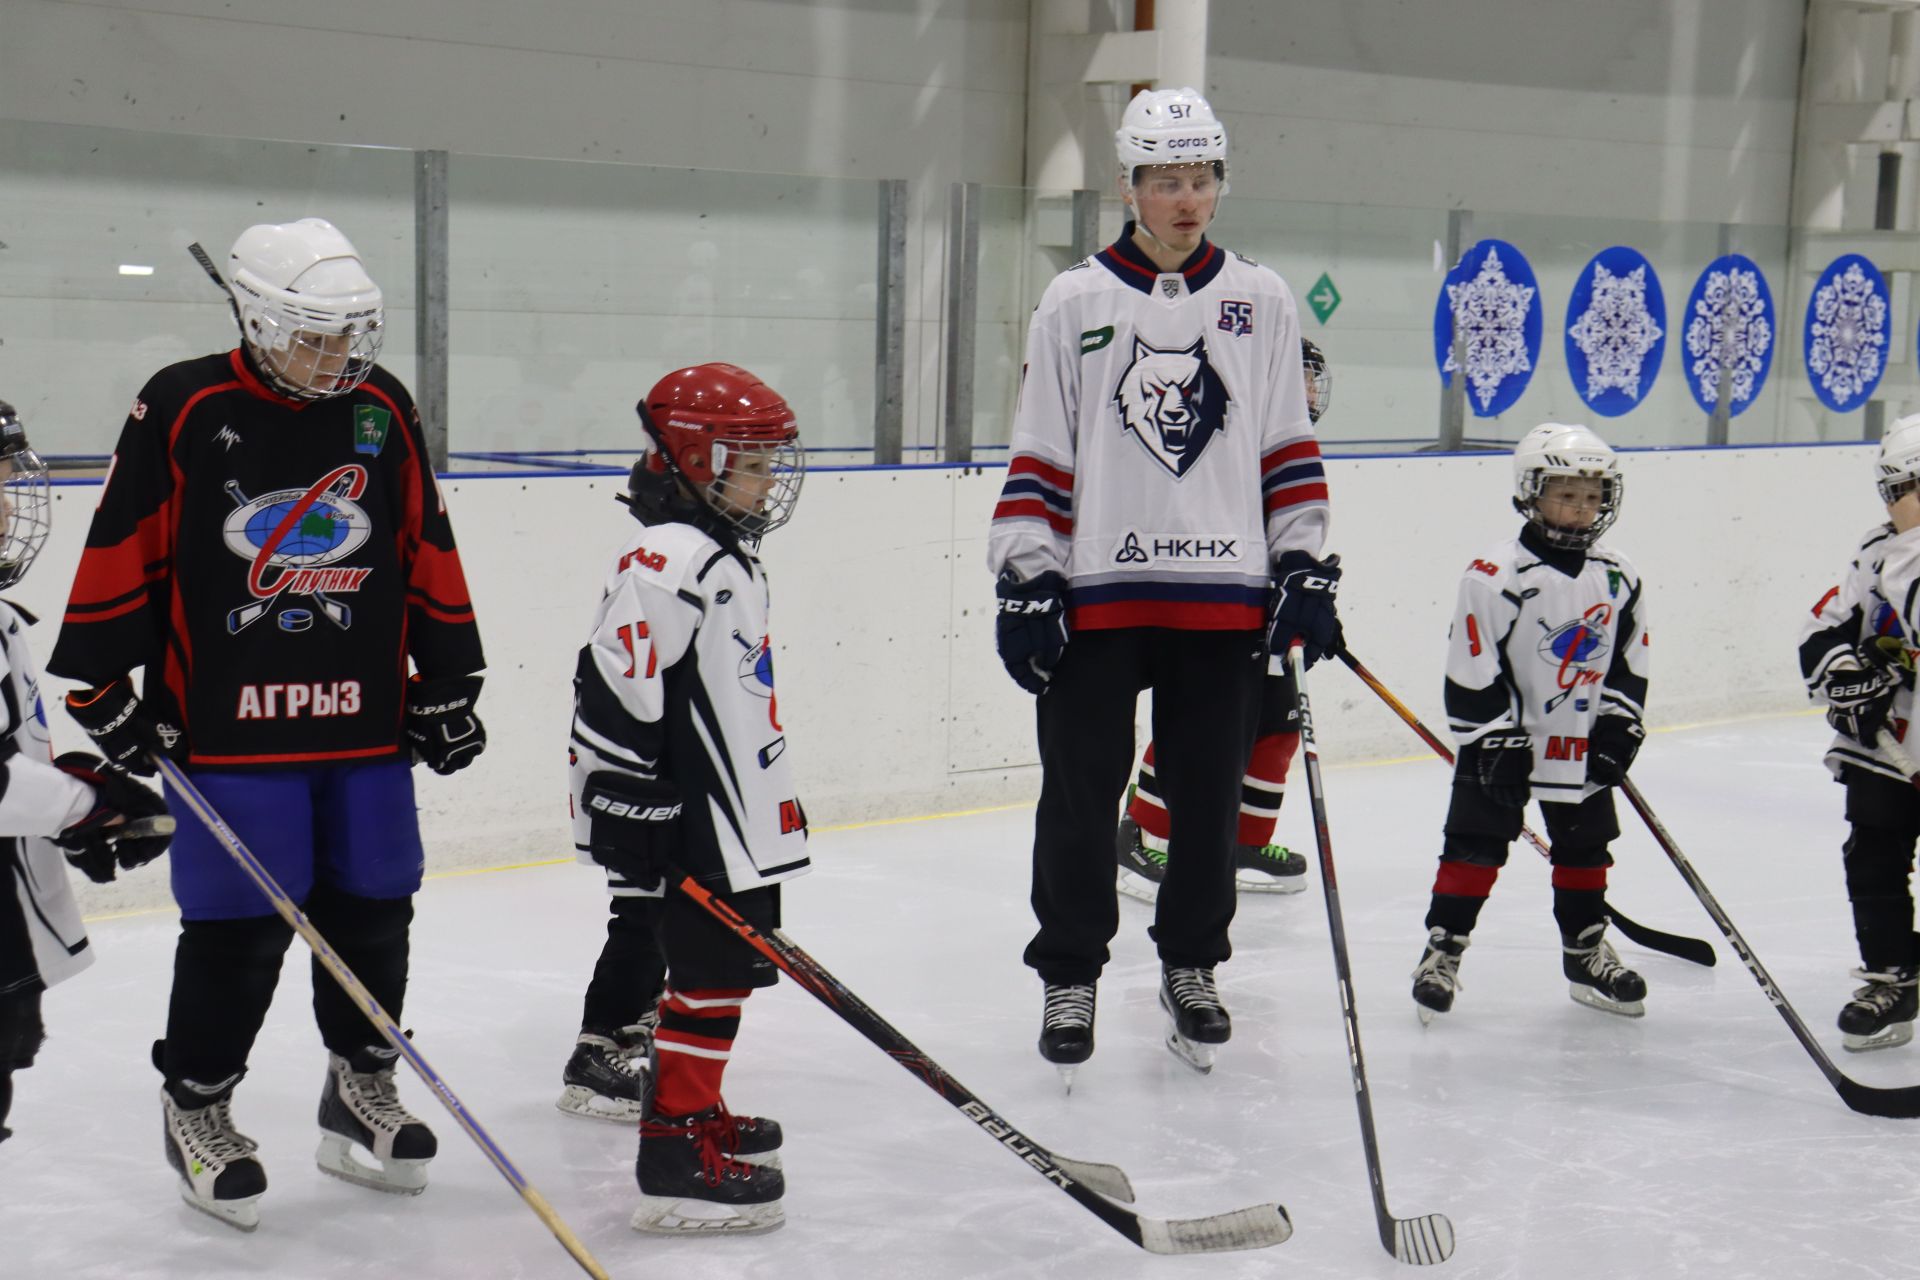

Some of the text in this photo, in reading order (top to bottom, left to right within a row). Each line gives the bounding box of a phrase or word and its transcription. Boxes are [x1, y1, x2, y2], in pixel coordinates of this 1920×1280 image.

[1168, 104, 1191, 119] 97
[1223, 302, 1252, 326] 55
[1154, 539, 1237, 557] НКНХ
[1302, 576, 1339, 593] CC
[237, 680, 361, 720] АГРЫЗ
[1544, 735, 1590, 761] АГР
[590, 794, 683, 821] BAUER
[958, 1100, 1075, 1189] BAUER
